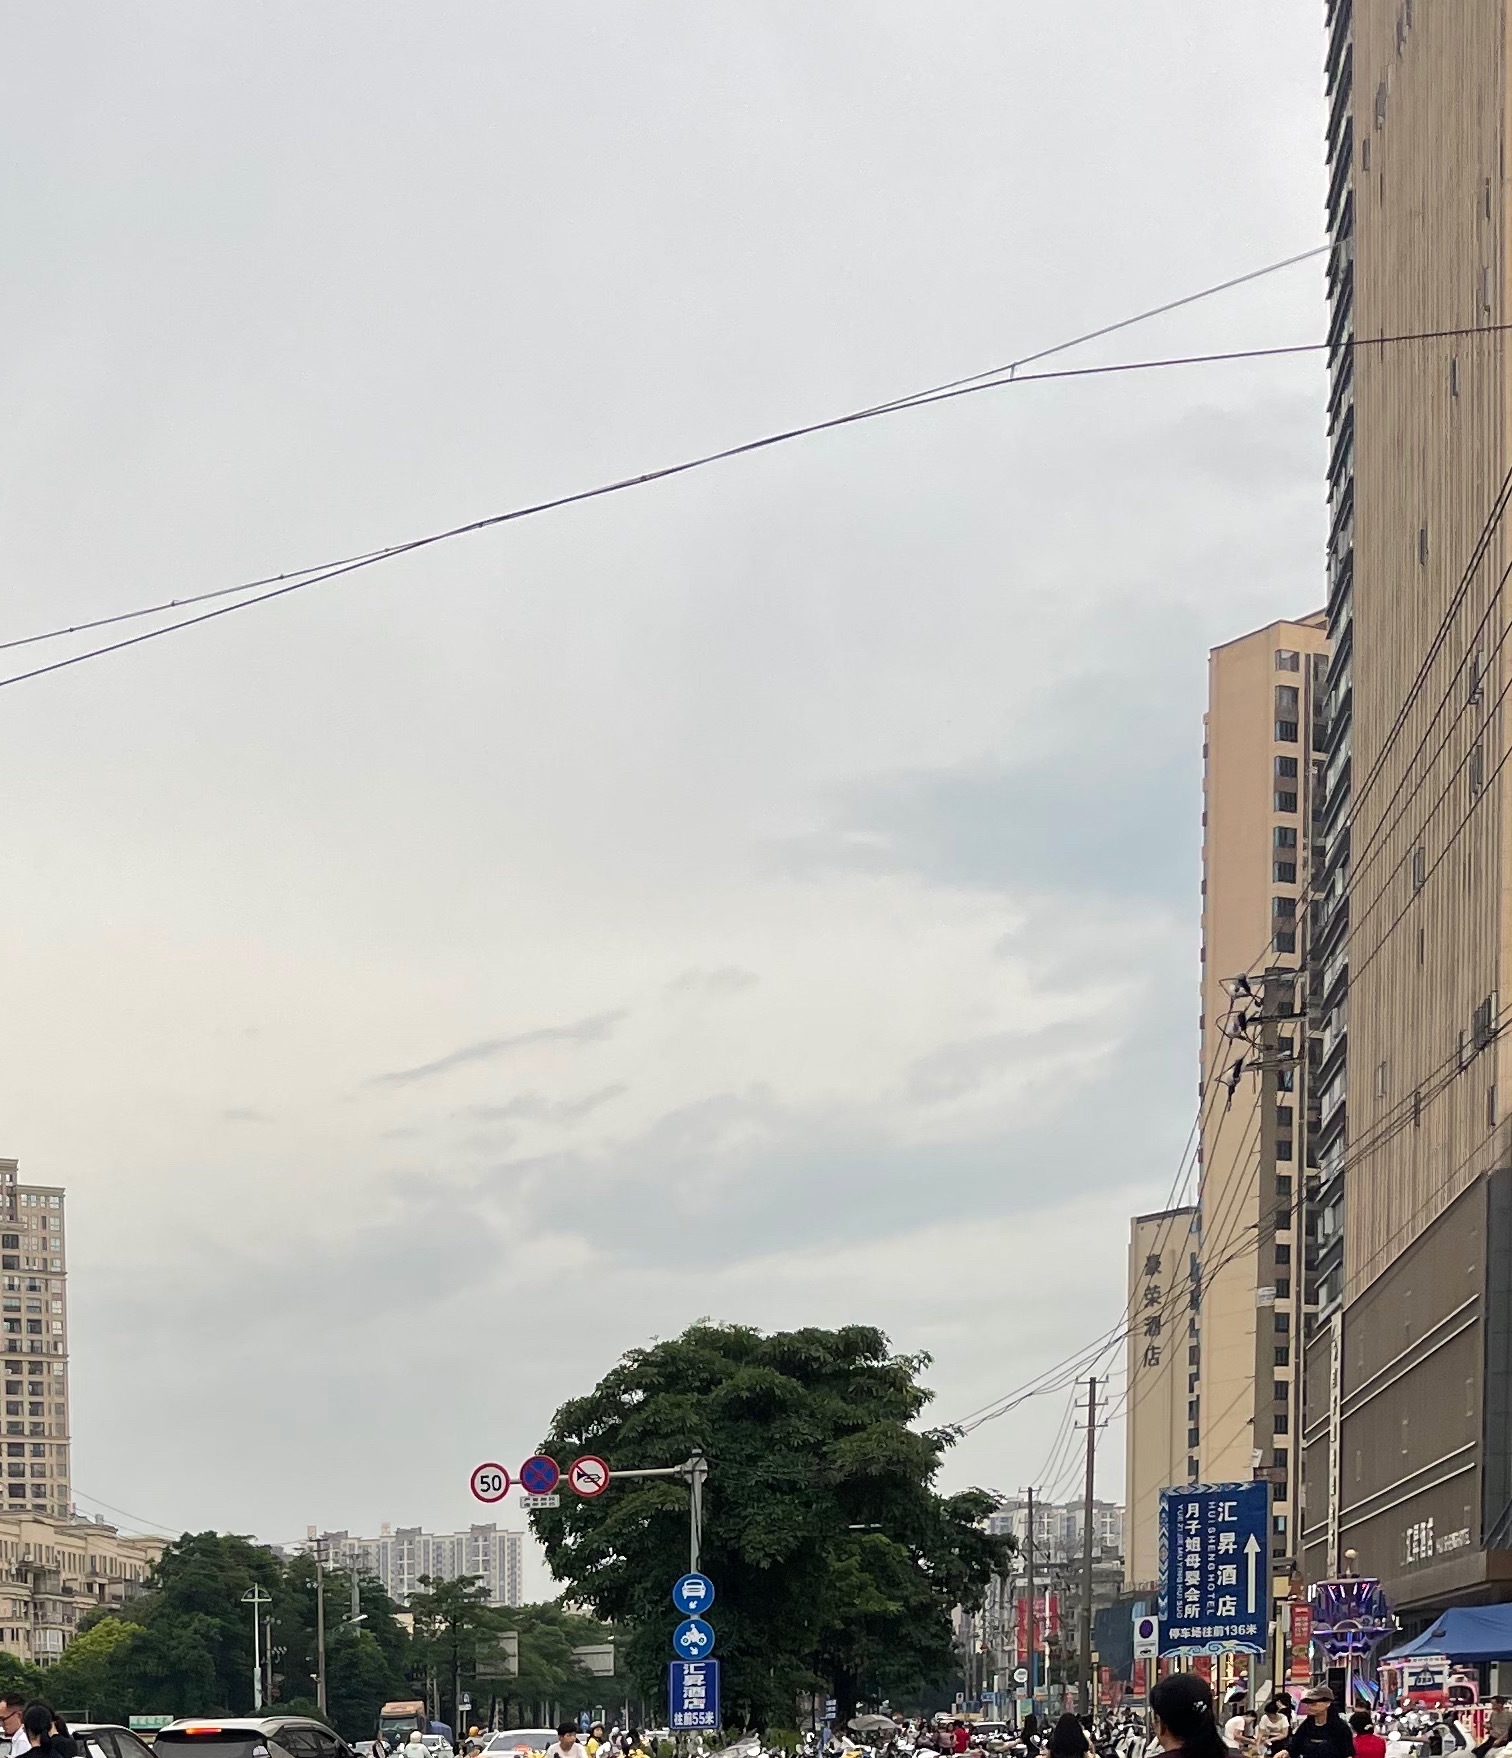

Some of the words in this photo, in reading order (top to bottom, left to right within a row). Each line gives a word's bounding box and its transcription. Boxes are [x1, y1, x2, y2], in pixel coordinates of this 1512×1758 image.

[480, 1474, 502, 1492] 50
[1184, 1502, 1202, 1619] 月子姐母婴会所
[1216, 1500, 1238, 1618] 汇昇酒店
[1168, 1623, 1258, 1640] 停车场往前136米
[673, 1711, 715, 1726] 往前55米
